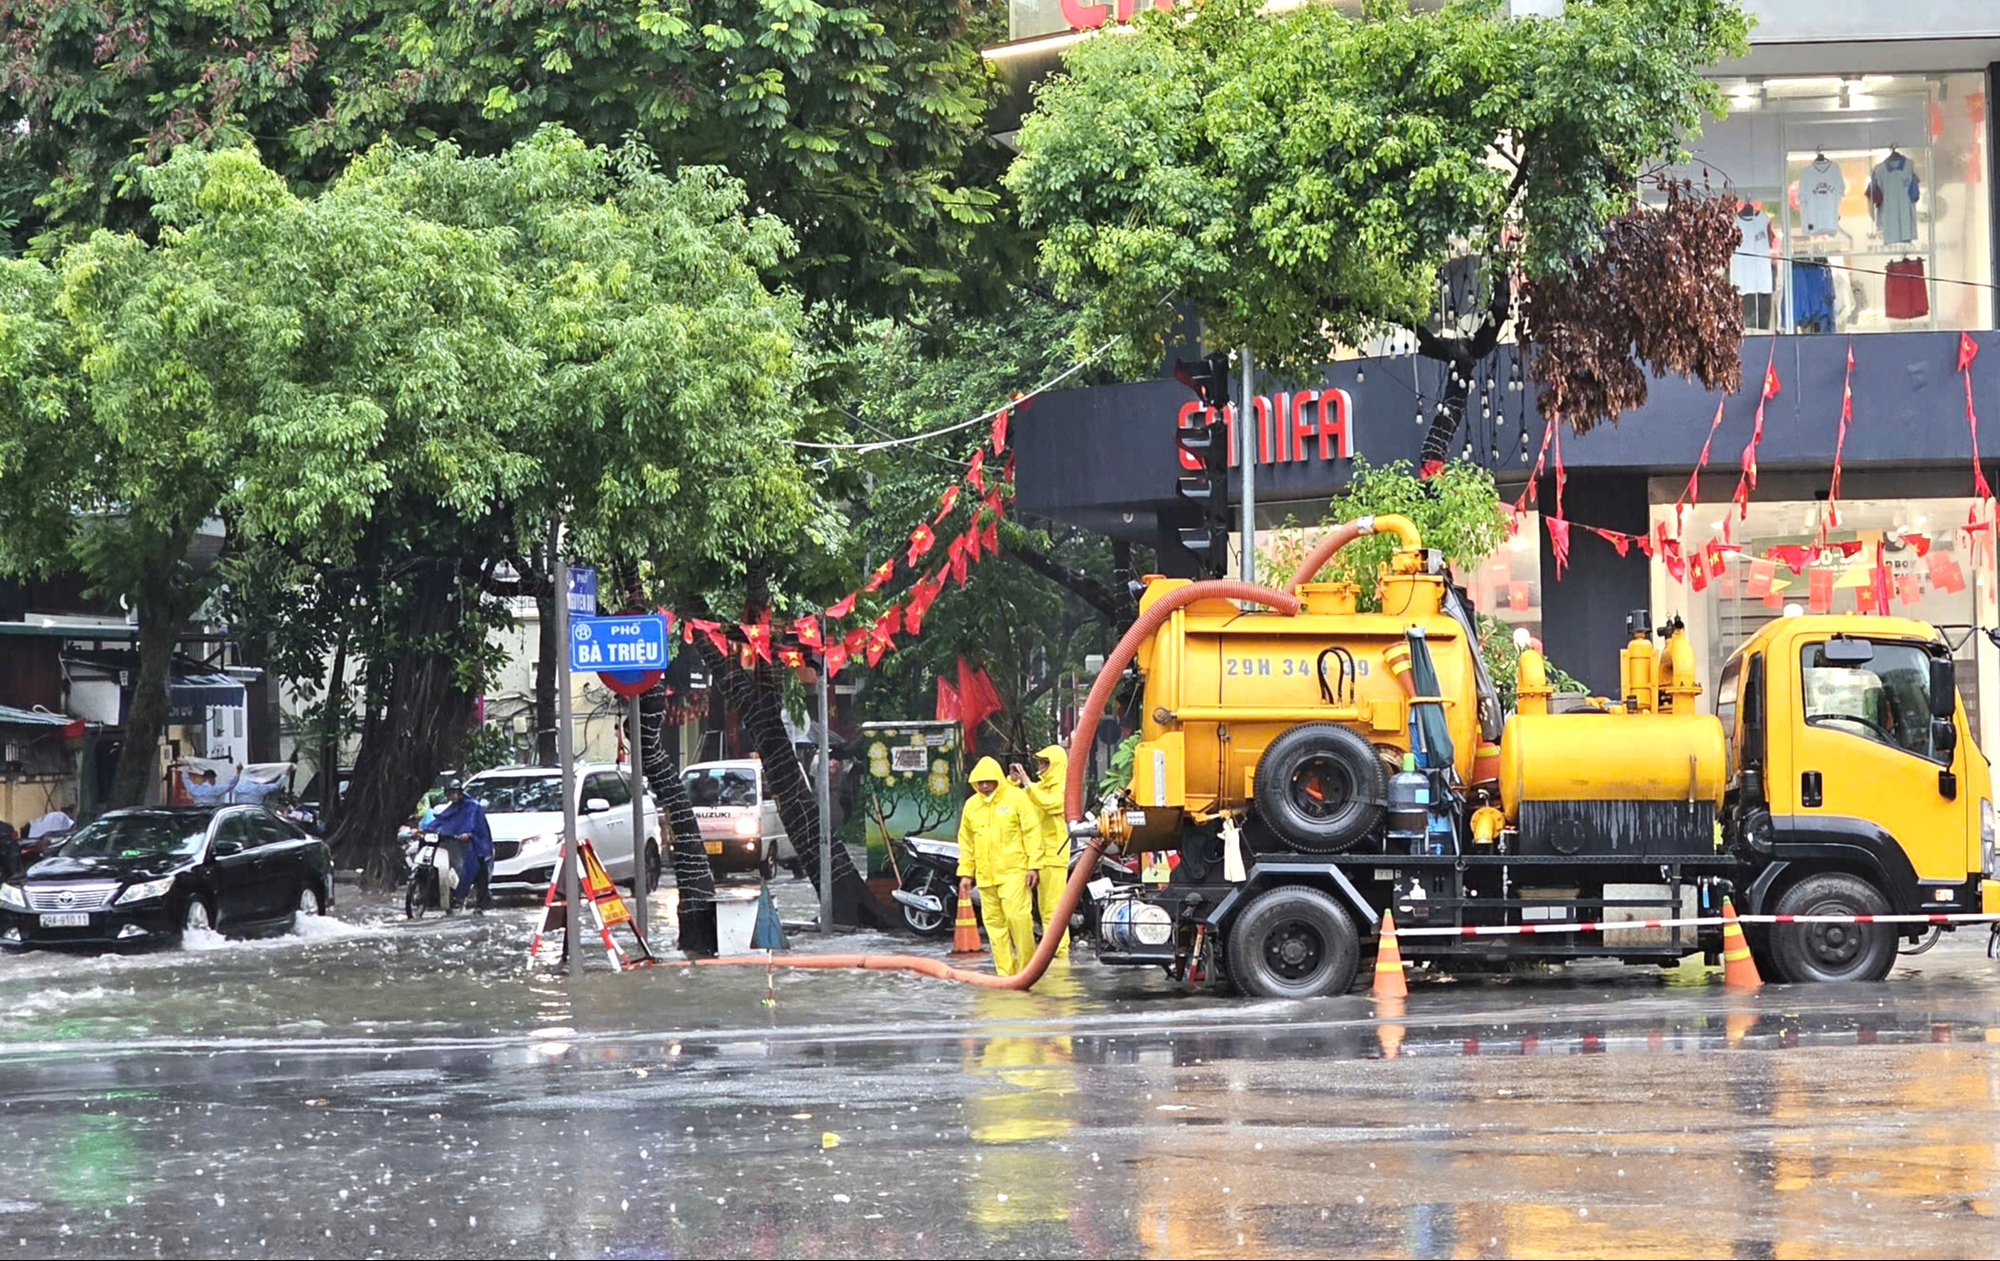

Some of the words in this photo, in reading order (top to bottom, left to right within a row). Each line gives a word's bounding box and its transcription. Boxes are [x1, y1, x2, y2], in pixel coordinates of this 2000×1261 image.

[610, 621, 641, 636] PHỐ
[578, 639, 603, 663] BÀ
[607, 638, 658, 665] TRIỆU
[1226, 659, 1271, 676] 29H
